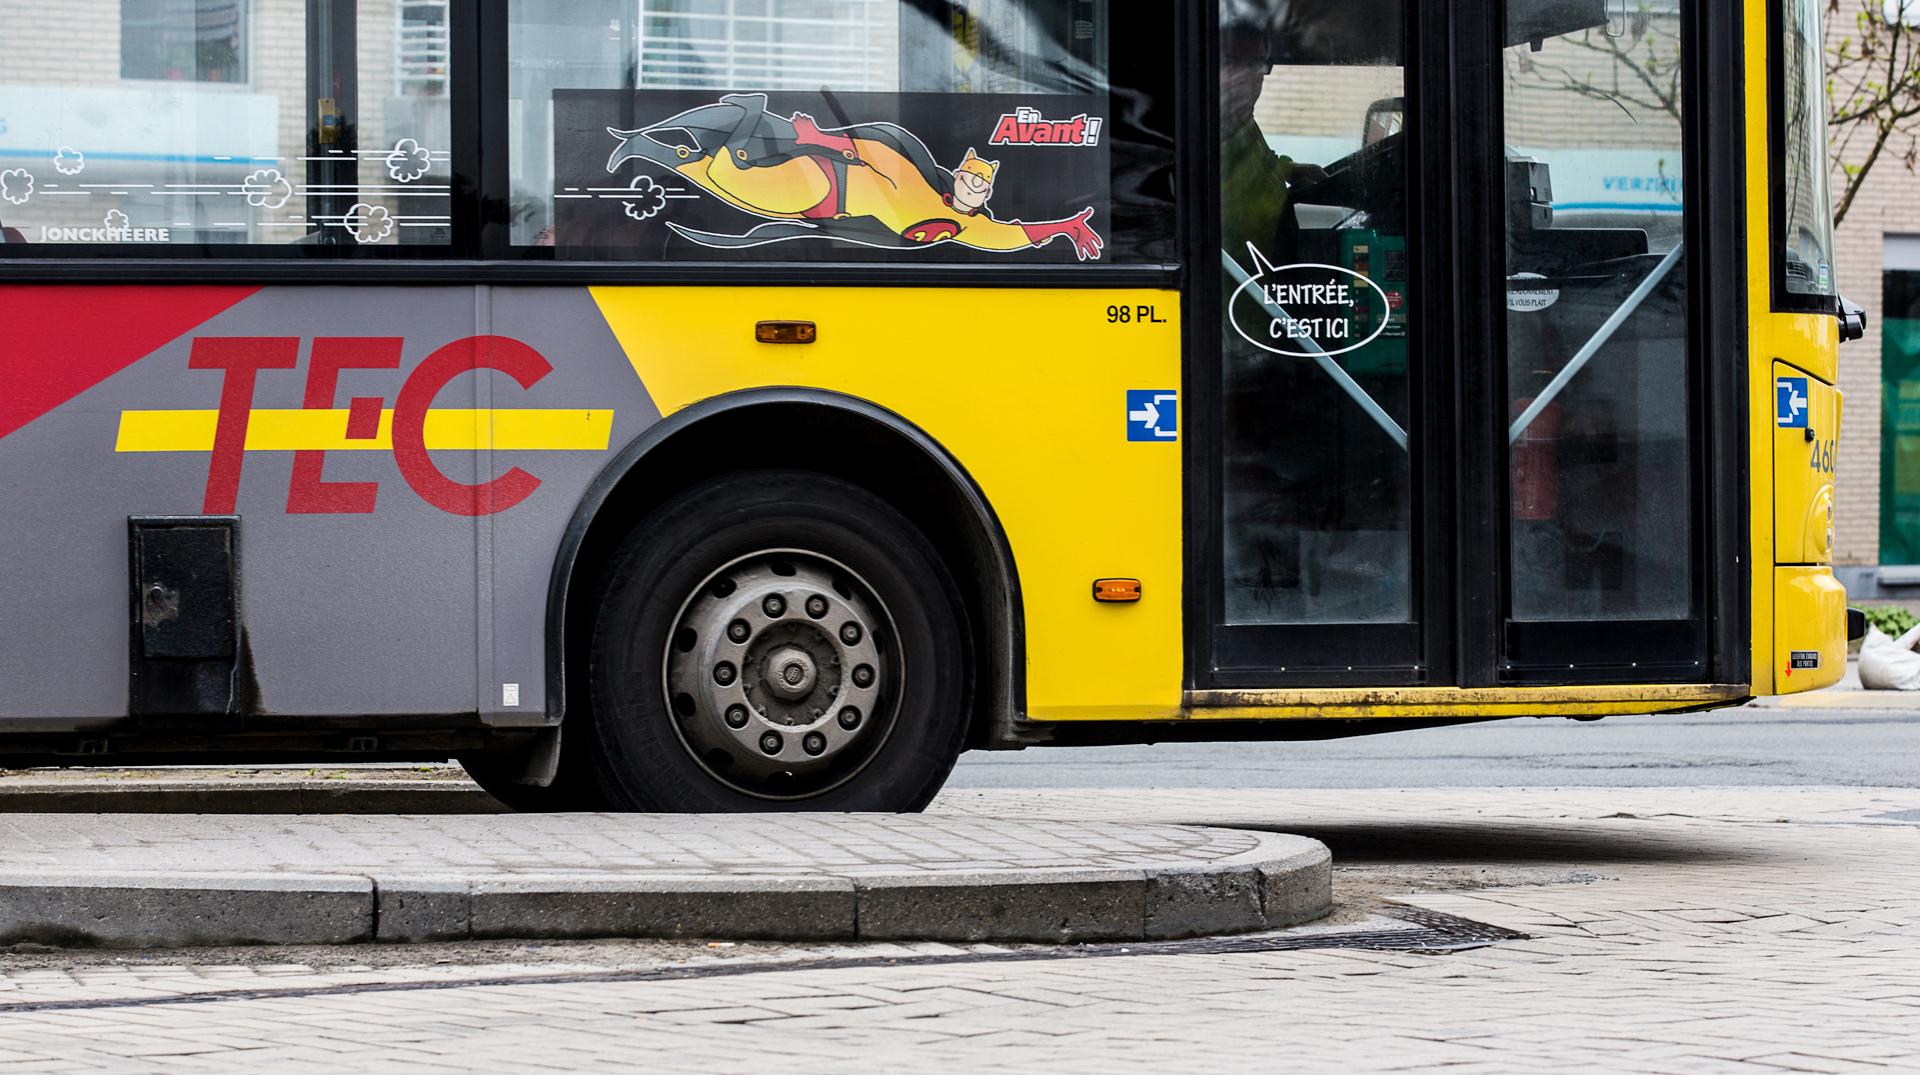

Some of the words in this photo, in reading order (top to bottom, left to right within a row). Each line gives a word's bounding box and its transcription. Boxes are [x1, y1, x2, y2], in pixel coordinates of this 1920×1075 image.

[1017, 109, 1039, 123] En
[993, 116, 1101, 144] Avant!
[40, 226, 170, 242] JONCKHEERE
[1263, 278, 1354, 307] L'ENTRÉE,
[1106, 305, 1131, 323] 98
[1137, 305, 1167, 323] PL.
[1269, 317, 1323, 338] C'EST
[1326, 317, 1348, 338] ICI
[188, 334, 554, 517] TEC
